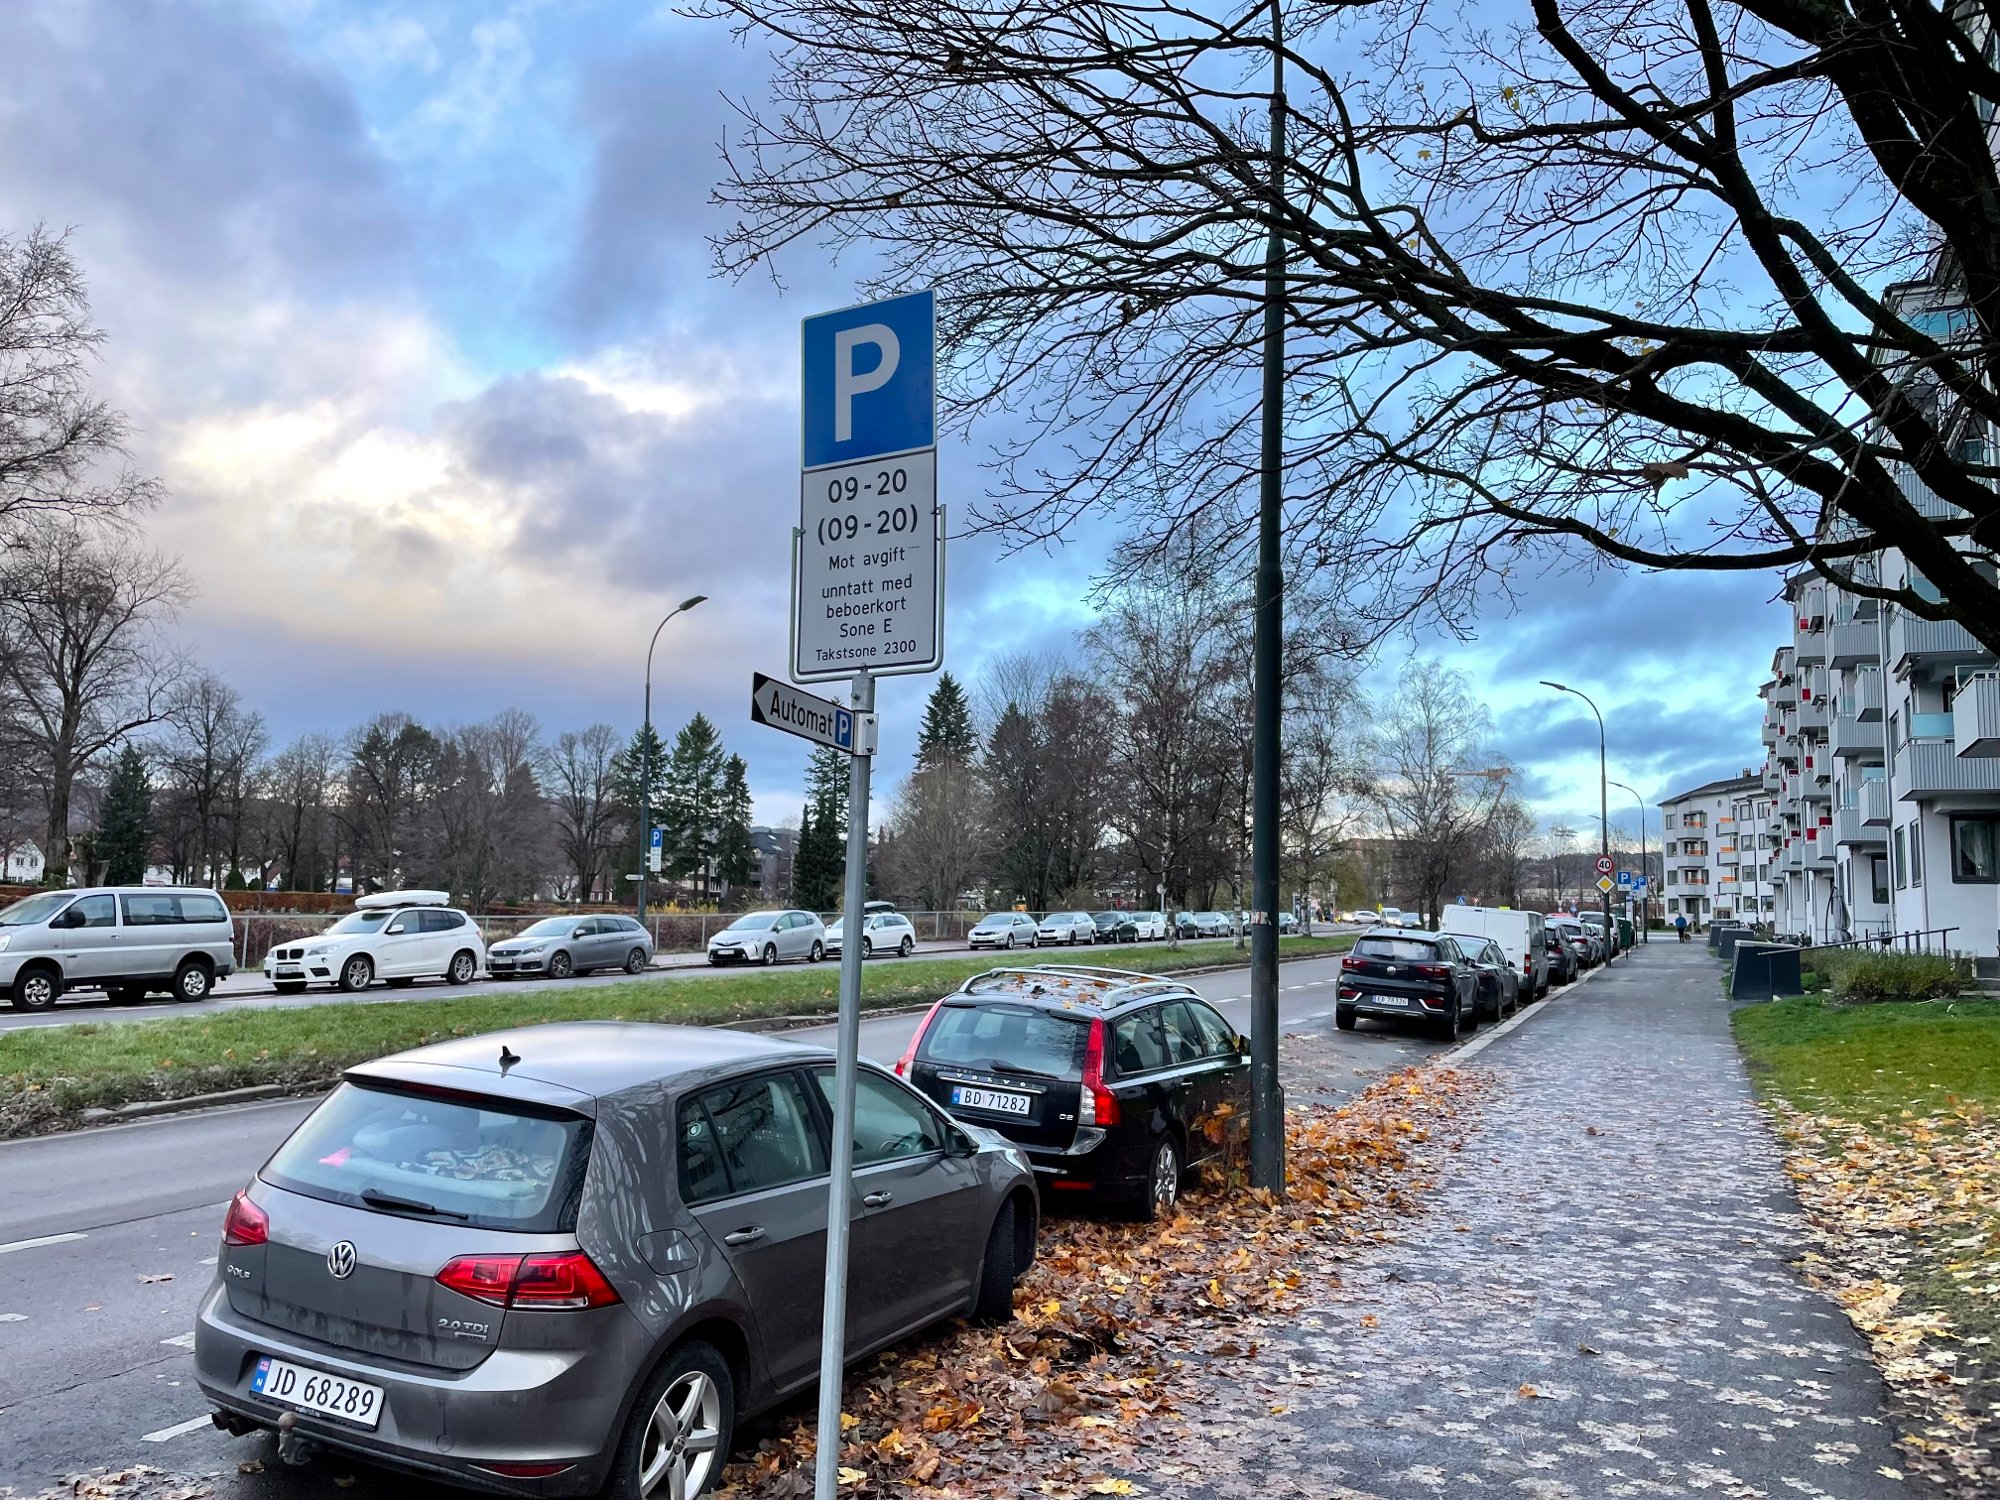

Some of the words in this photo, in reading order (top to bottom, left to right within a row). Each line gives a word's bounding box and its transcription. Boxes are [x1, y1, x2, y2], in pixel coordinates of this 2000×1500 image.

[835, 323, 900, 442] P
[829, 553, 855, 571] Mot
[863, 546, 905, 567] avgift
[822, 579, 873, 599] unntatt
[882, 573, 912, 592] med
[826, 596, 906, 619] beboerkort
[840, 622, 875, 638] Sone
[884, 618, 892, 633] E
[816, 646, 877, 661] Takstsone
[884, 639, 917, 655] 2300
[770, 690, 833, 737] Automat
[838, 713, 849, 743] P
[653, 831, 660, 846] P
[1598, 860, 1611, 870] 40
[1621, 873, 1629, 883] P
[956, 1073, 1027, 1088] VOLVO
[964, 1090, 981, 1105] BD
[988, 1093, 1026, 1112] 71282
[1059, 1113, 1074, 1121] D2
[463, 1322, 489, 1333] TDI
[256, 1377, 264, 1387] N
[270, 1367, 297, 1396] JD
[304, 1376, 375, 1417] 68289
